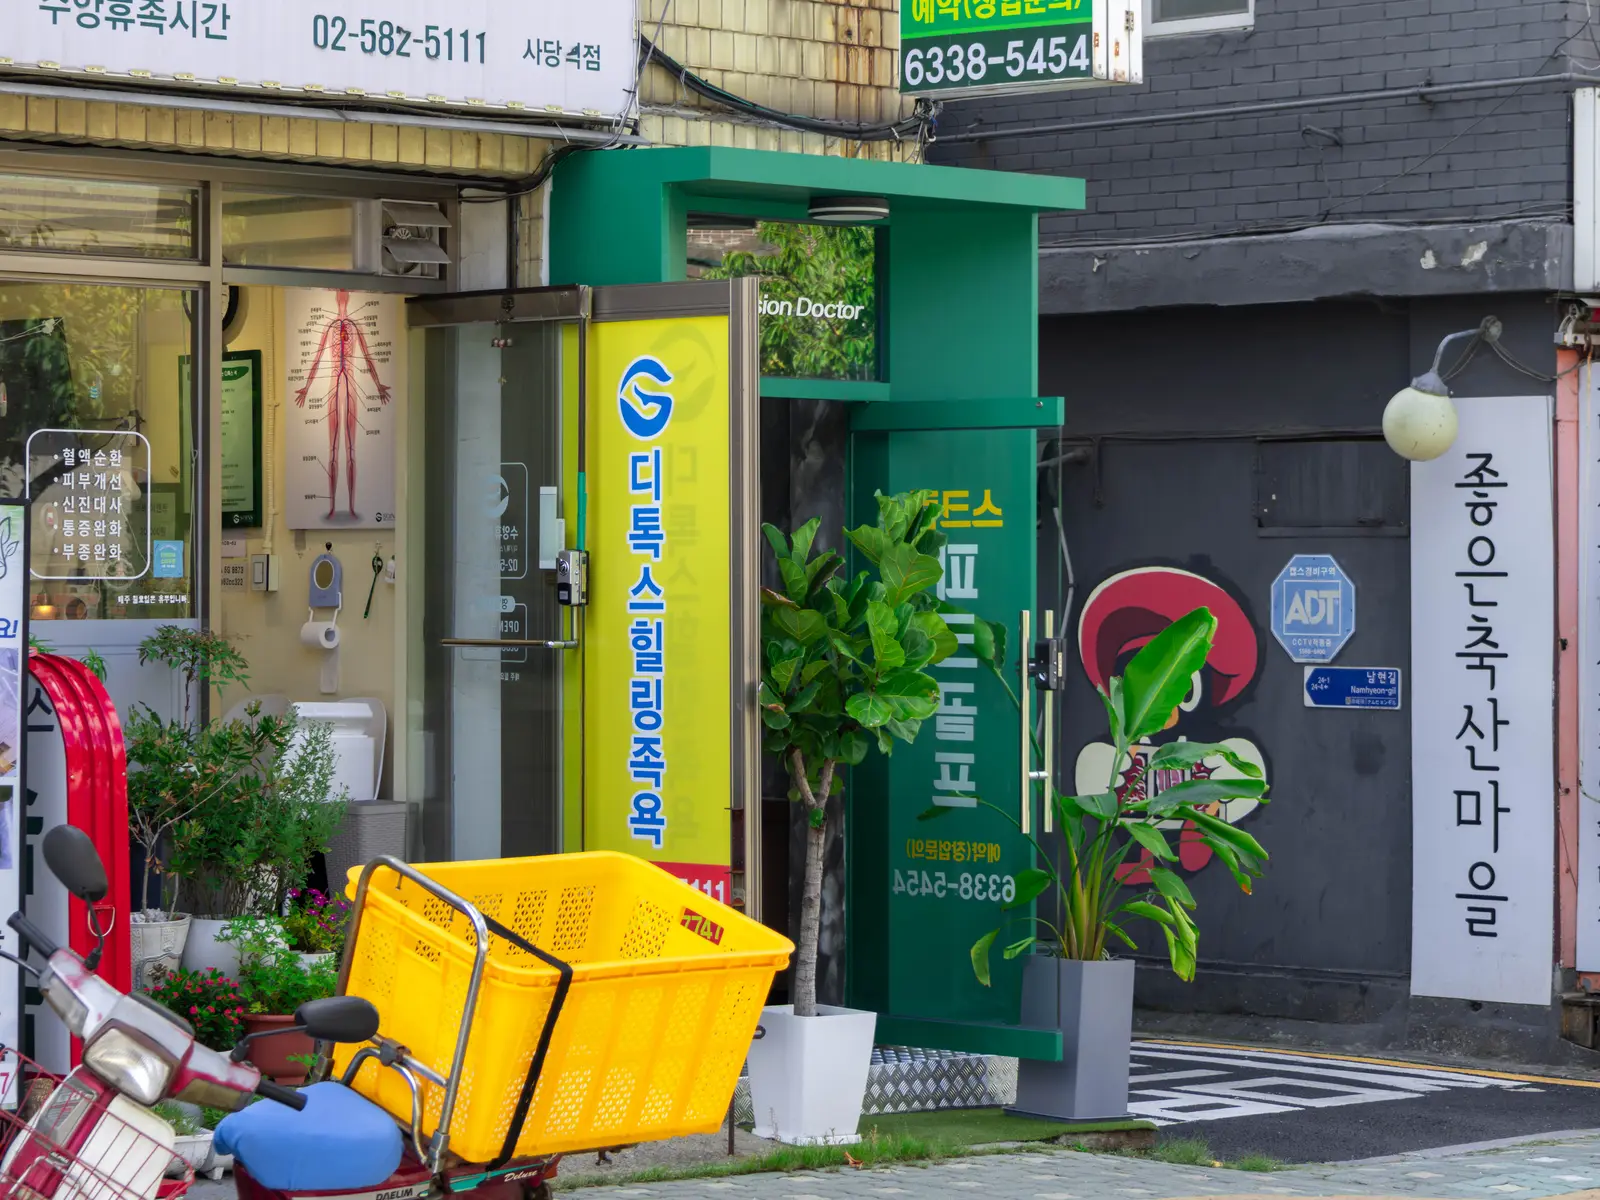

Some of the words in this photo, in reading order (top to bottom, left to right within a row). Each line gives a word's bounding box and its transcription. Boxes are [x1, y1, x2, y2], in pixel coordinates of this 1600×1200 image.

[312, 14, 487, 64] 02-582-5111
[904, 33, 1090, 86] 6338-5454
[796, 297, 865, 320] Doctor
[62, 448, 122, 467] 혈액순환
[62, 472, 122, 491] 피부개선
[62, 496, 122, 514] 신진대사
[62, 519, 122, 537] 통증완화
[62, 543, 122, 561] 부종완화
[1285, 589, 1341, 626] ADT
[628, 448, 666, 847] 디톡스힐링족욕
[1366, 671, 1396, 685] 남현길
[1350, 685, 1397, 696] Namhyeon-gil
[1454, 453, 1511, 938] 좋은축산마을
[503, 1169, 538, 1182] Deluxe
[375, 1187, 413, 1200] DAELIM
